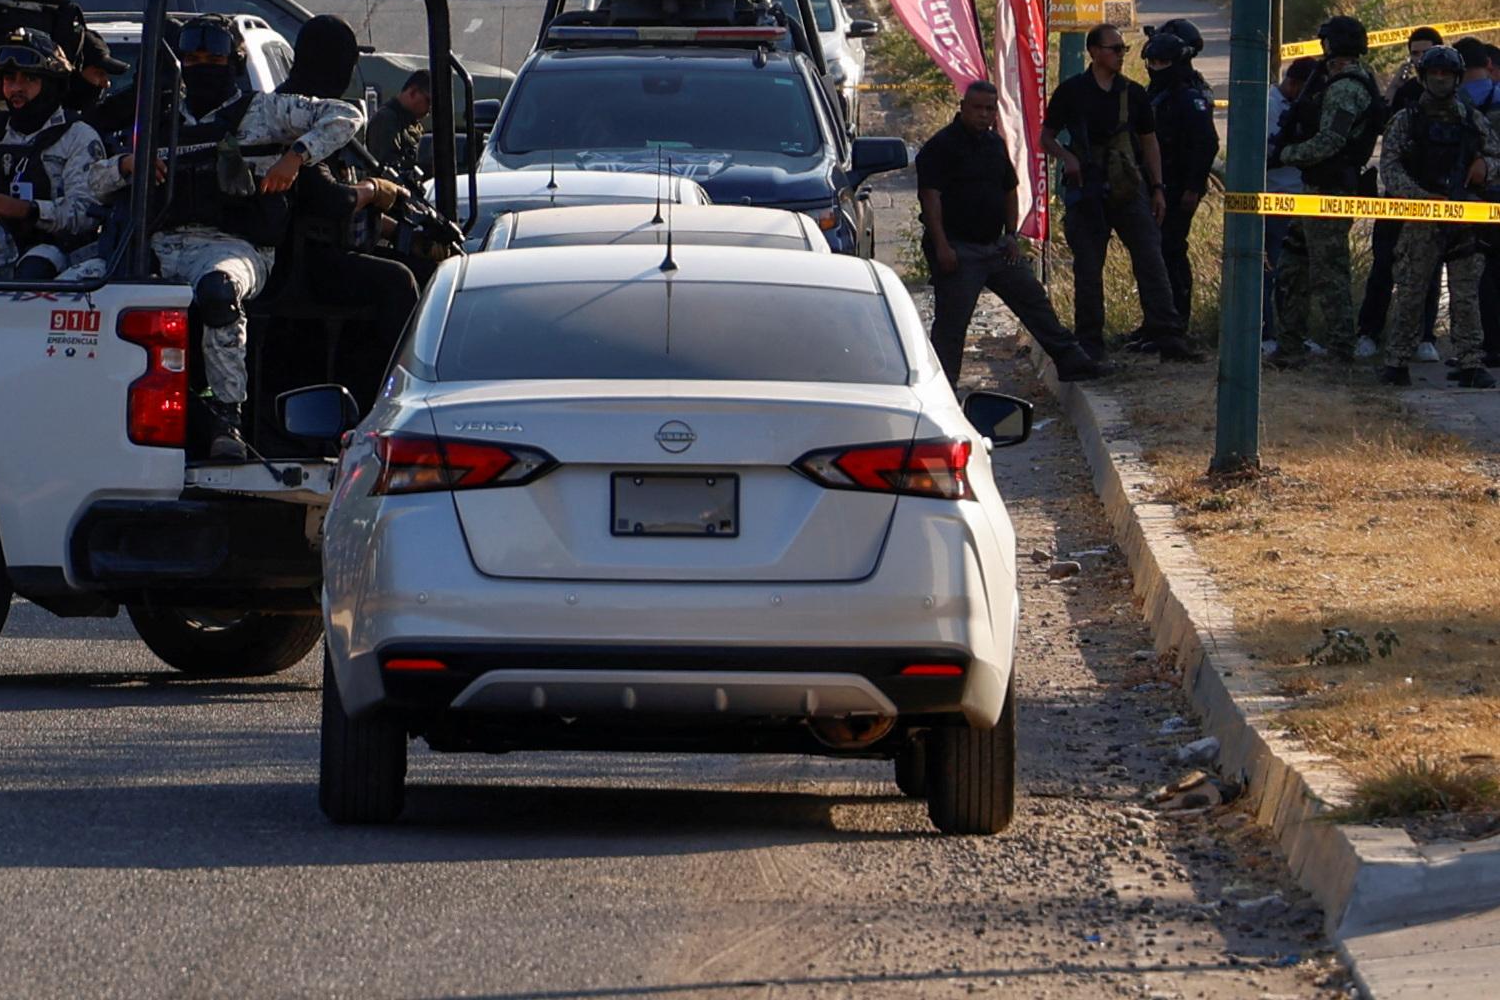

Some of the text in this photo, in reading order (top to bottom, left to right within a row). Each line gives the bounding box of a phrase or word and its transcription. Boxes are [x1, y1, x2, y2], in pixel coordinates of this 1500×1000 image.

[1263, 196, 1273, 211] EL
[1275, 197, 1296, 212] PASO
[1320, 198, 1465, 219] LINEA DE POLICIA PROHIBIDO EL PASO
[54, 312, 95, 329] 911
[47, 337, 98, 345] EMERGENCIAS
